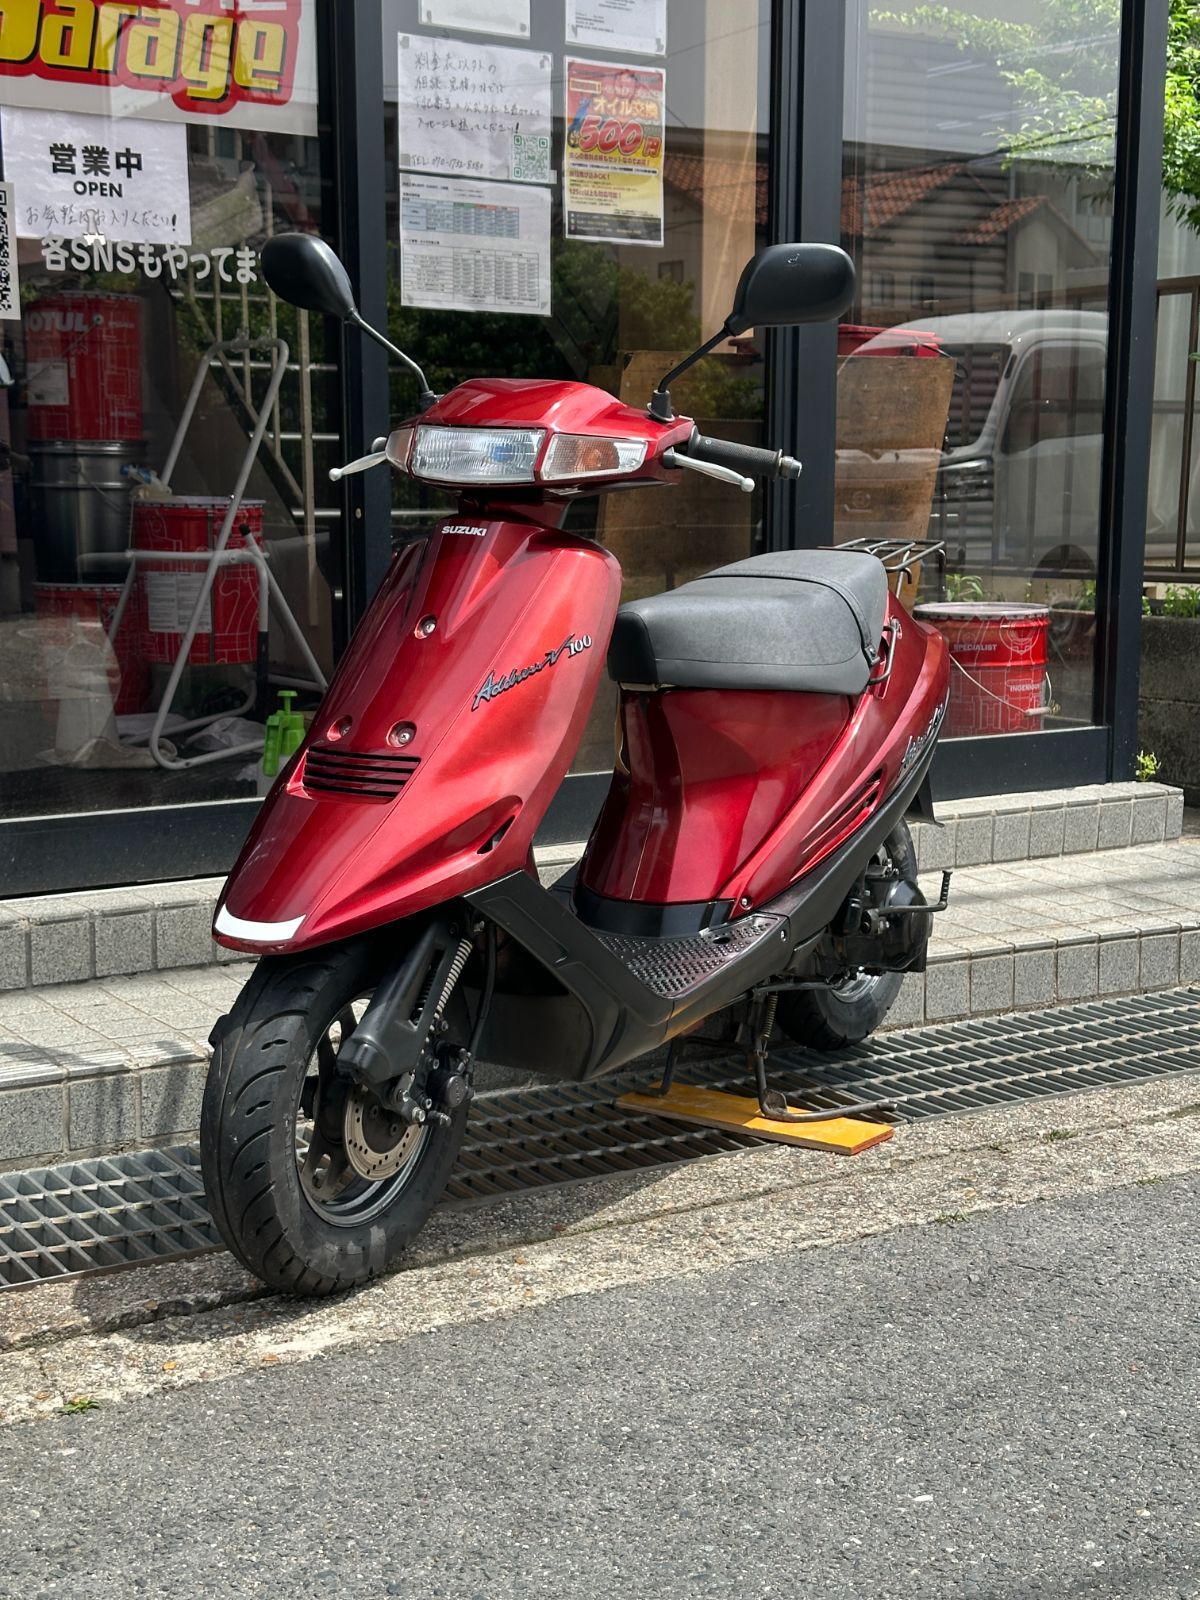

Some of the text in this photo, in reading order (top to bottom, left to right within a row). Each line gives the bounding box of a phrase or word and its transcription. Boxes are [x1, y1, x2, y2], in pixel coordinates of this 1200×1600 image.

[50, 143, 143, 179] 営業中
[73, 180, 123, 198] OPEN
[41, 236, 262, 284] 各SNSもやってま
[441, 525, 488, 537] SUZUKI
[953, 643, 998, 651] SPECIALIST
